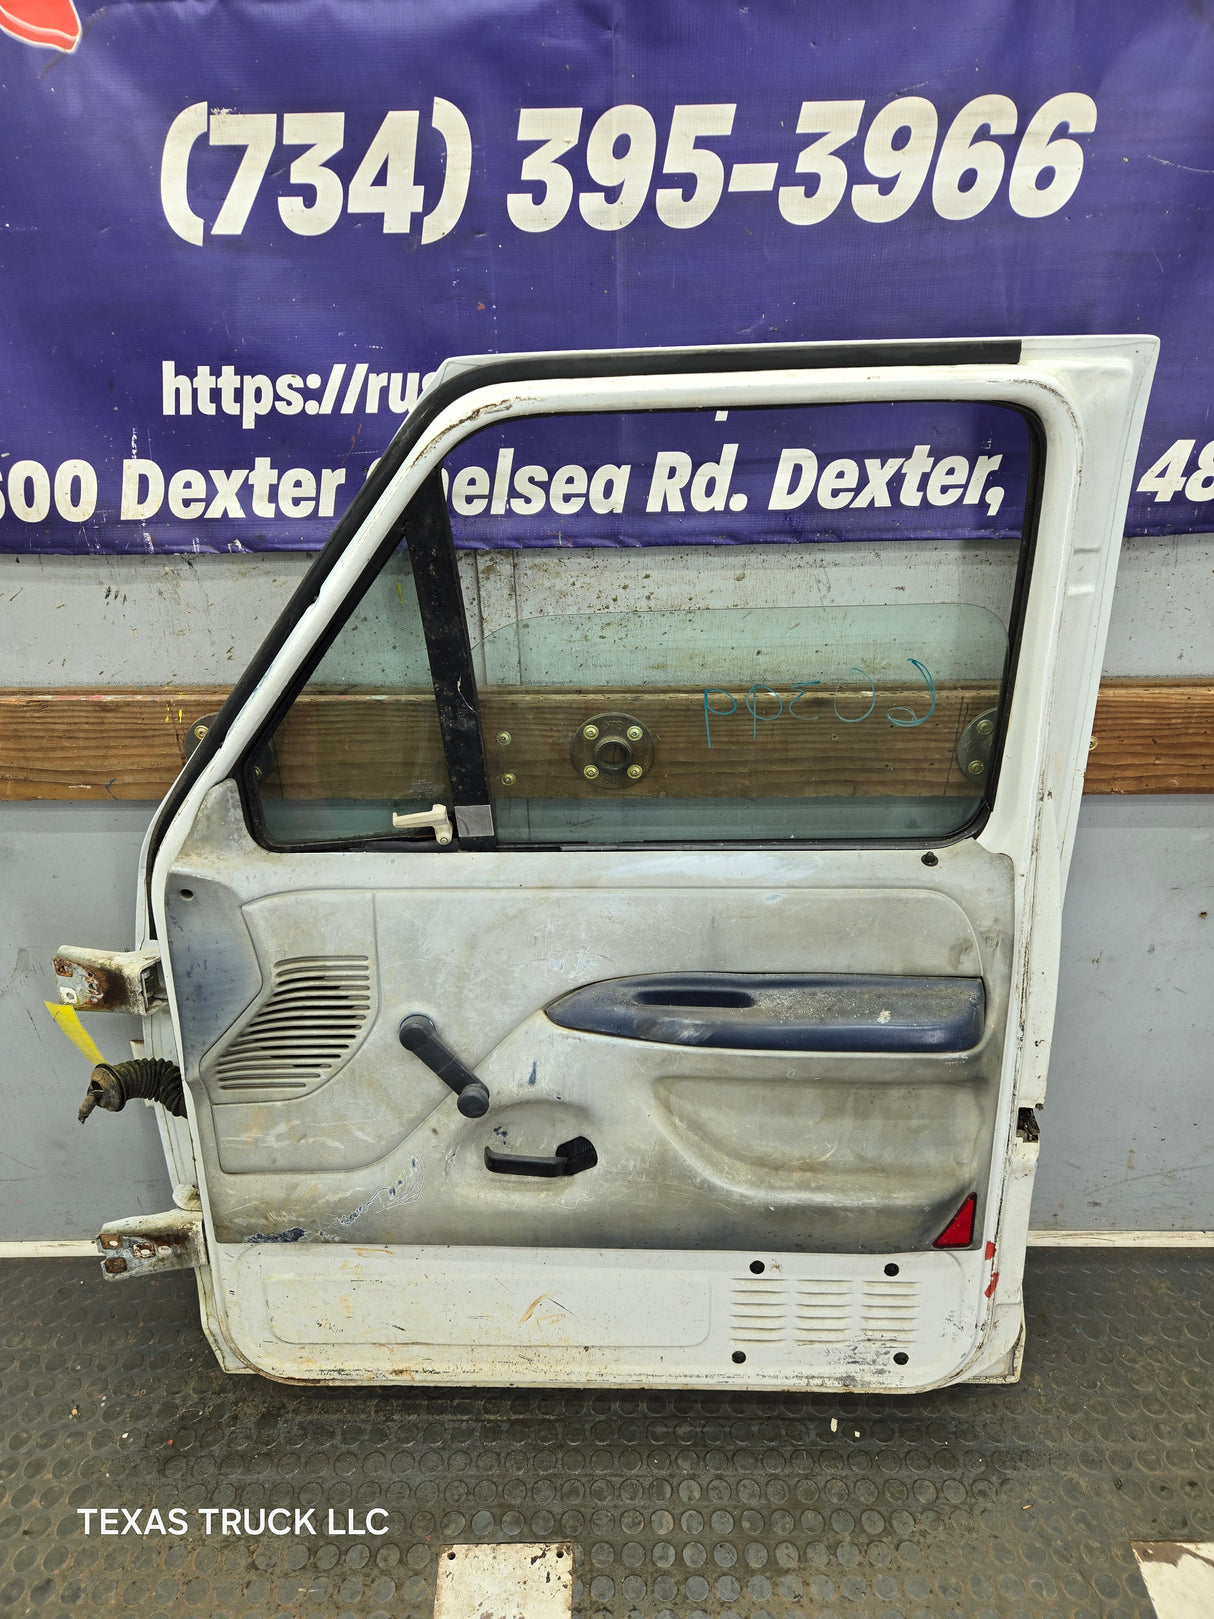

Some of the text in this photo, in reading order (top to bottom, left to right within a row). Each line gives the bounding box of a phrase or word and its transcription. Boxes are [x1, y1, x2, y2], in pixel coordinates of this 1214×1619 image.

[161, 92, 1097, 247] (734) 395-3966
[0, 459, 97, 522] 00
[121, 457, 346, 520] Dexter
[366, 448, 632, 516] elsea
[646, 444, 747, 512] Rd.
[768, 445, 1004, 516] Dexter,
